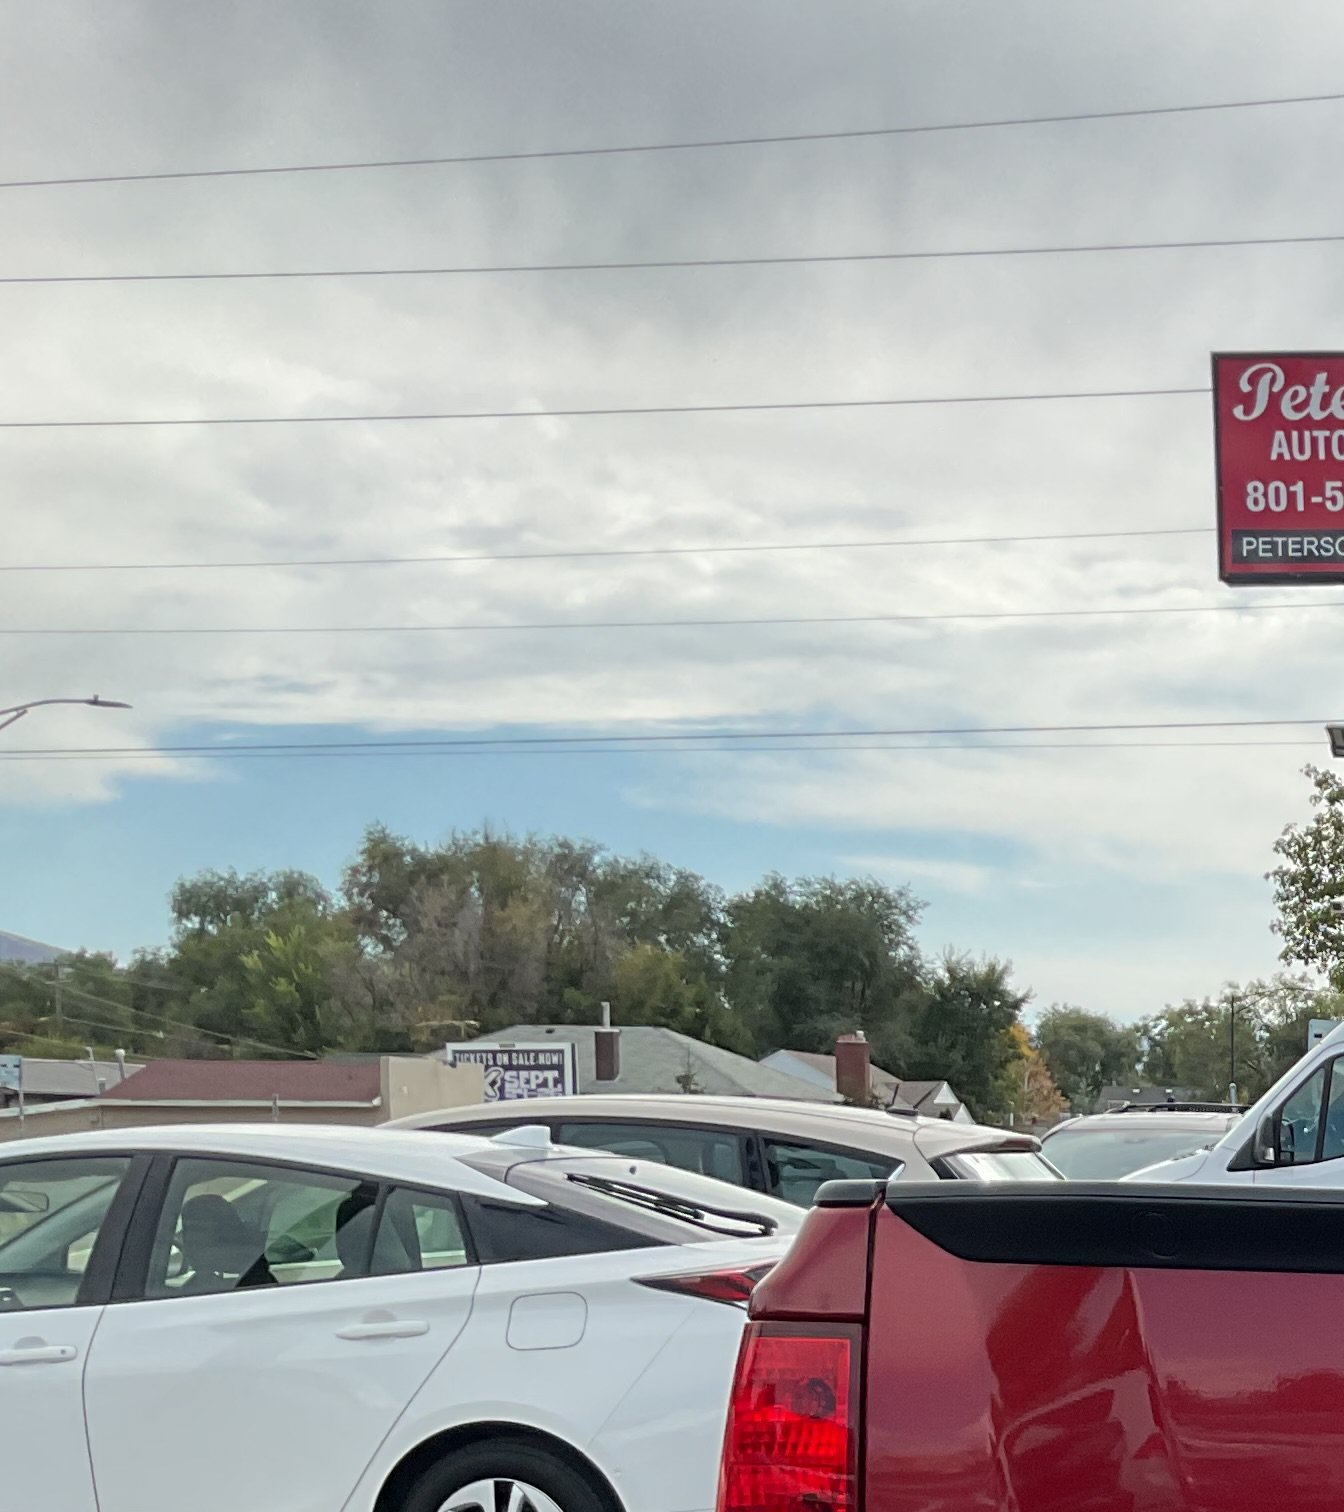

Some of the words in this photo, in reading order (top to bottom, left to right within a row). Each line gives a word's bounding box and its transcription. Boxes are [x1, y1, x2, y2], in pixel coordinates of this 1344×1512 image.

[455, 1053, 493, 1065] TICKETS
[497, 1053, 509, 1065] ON
[512, 1053, 535, 1066] SALE
[539, 1052, 562, 1065] NOW!
[504, 1070, 562, 1089] SEPT.
